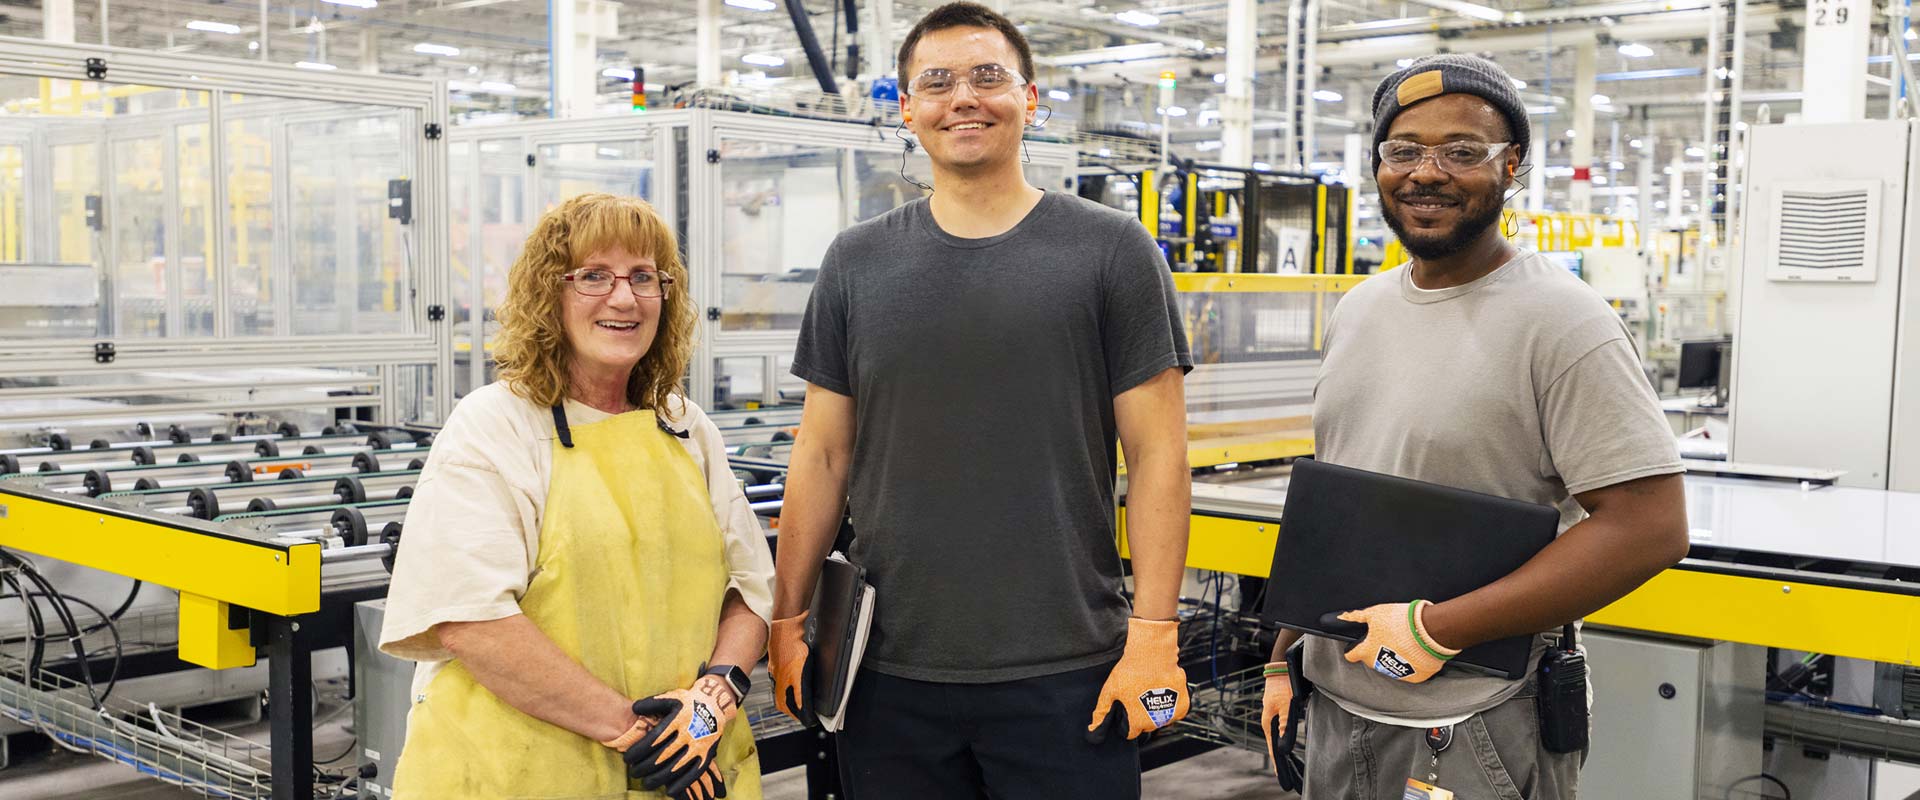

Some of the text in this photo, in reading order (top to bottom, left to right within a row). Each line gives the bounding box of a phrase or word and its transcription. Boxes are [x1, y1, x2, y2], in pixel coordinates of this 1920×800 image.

[1815, 8, 1848, 26] 29
[1282, 247, 1297, 269] A
[1380, 652, 1409, 675] HELIX
[1146, 694, 1173, 706] HELIX
